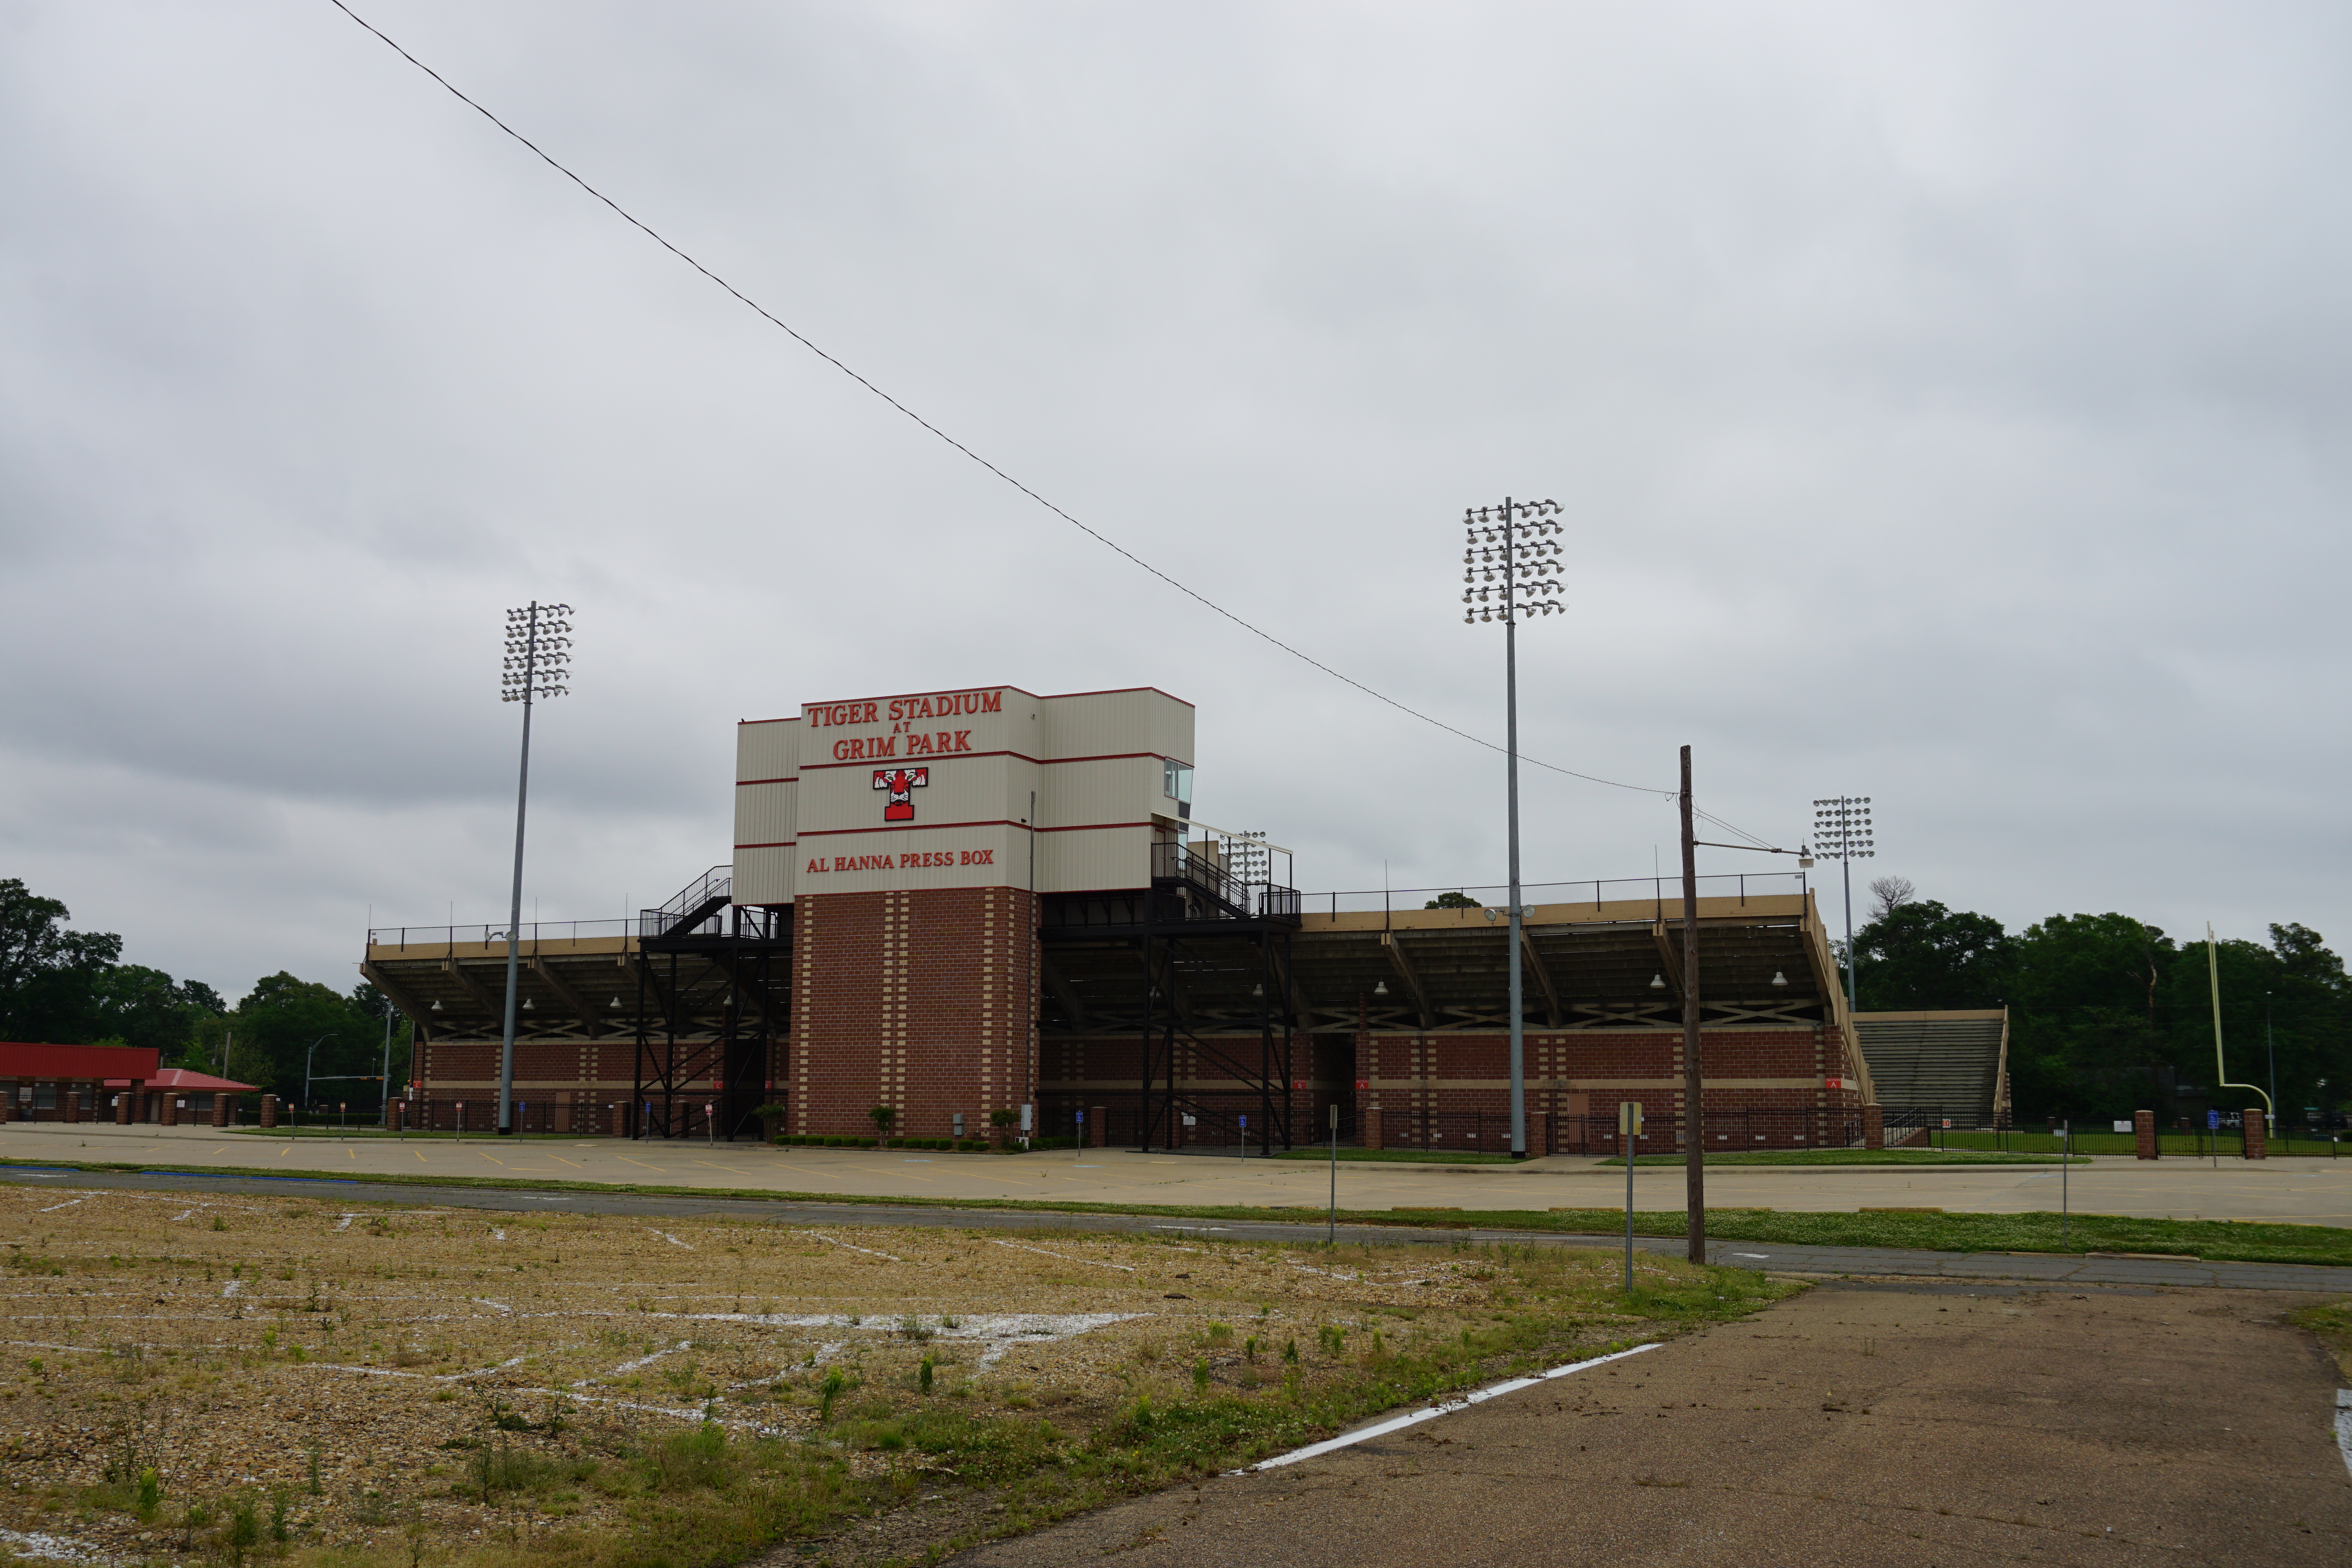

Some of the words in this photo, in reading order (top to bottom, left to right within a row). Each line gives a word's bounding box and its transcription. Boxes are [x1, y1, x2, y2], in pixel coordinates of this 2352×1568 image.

[808, 702, 879, 726] TIGER
[889, 691, 1002, 720] STADIUM
[893, 721, 911, 733] AT
[833, 736, 896, 760] GRIM
[906, 730, 971, 755] PARK
[806, 858, 829, 872] AL
[835, 854, 894, 870] HANNA
[900, 851, 954, 867] PRESS
[960, 849, 994, 865] BOX
